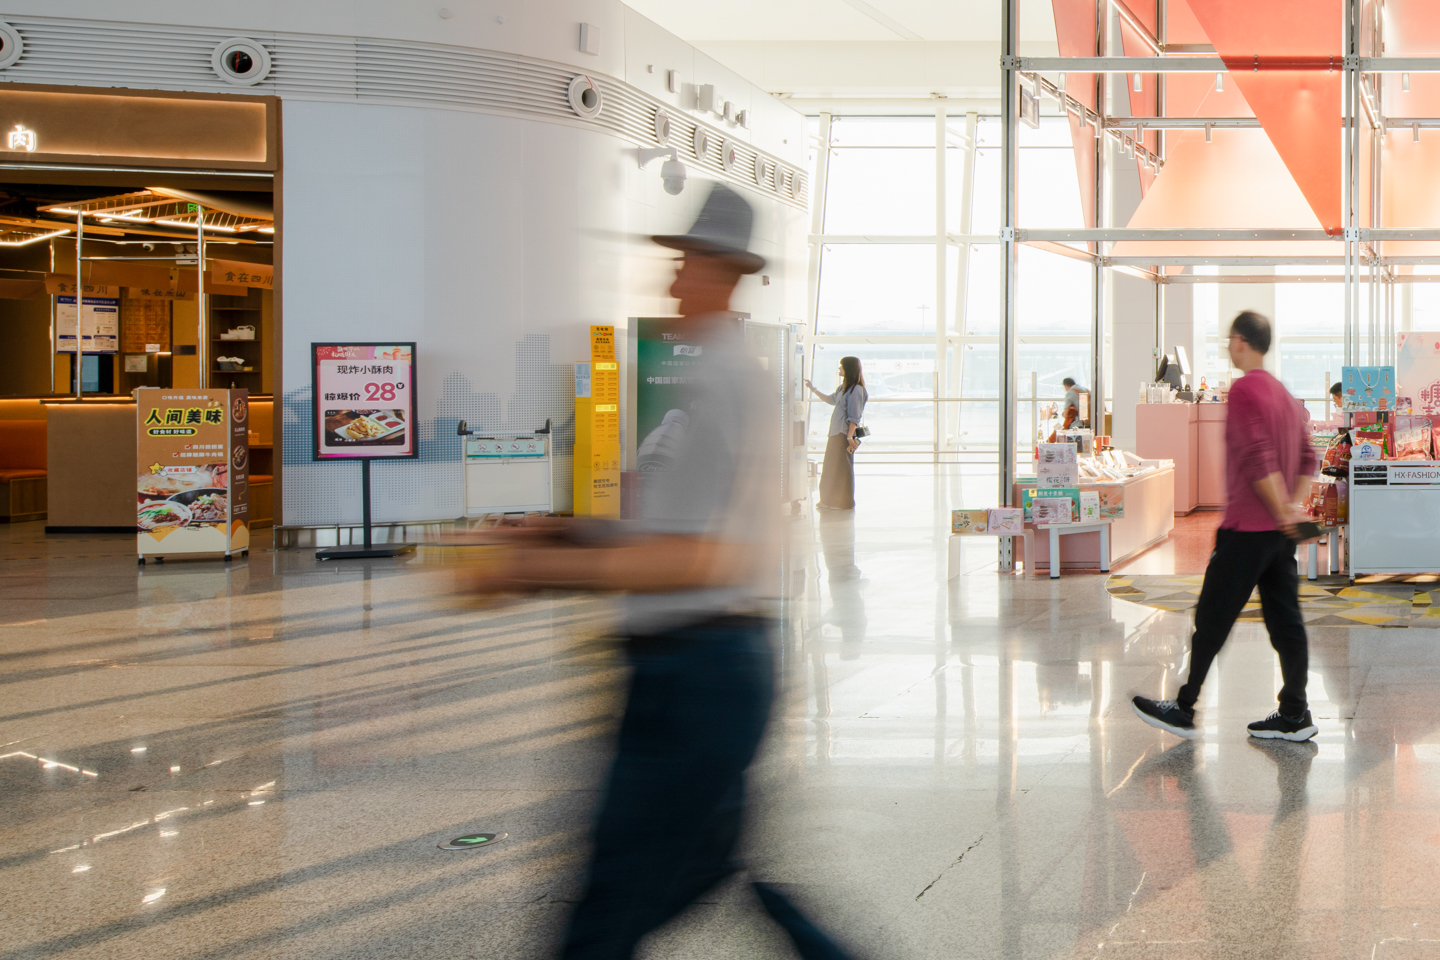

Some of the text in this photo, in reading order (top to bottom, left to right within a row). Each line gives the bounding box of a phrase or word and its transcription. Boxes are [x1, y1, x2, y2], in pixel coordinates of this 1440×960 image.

[9, 125, 35, 152] 肉
[337, 365, 393, 375] 现炸小酥肉
[325, 392, 361, 401] 惊爆价
[364, 382, 396, 402] 28
[145, 408, 223, 425] 人间美味
